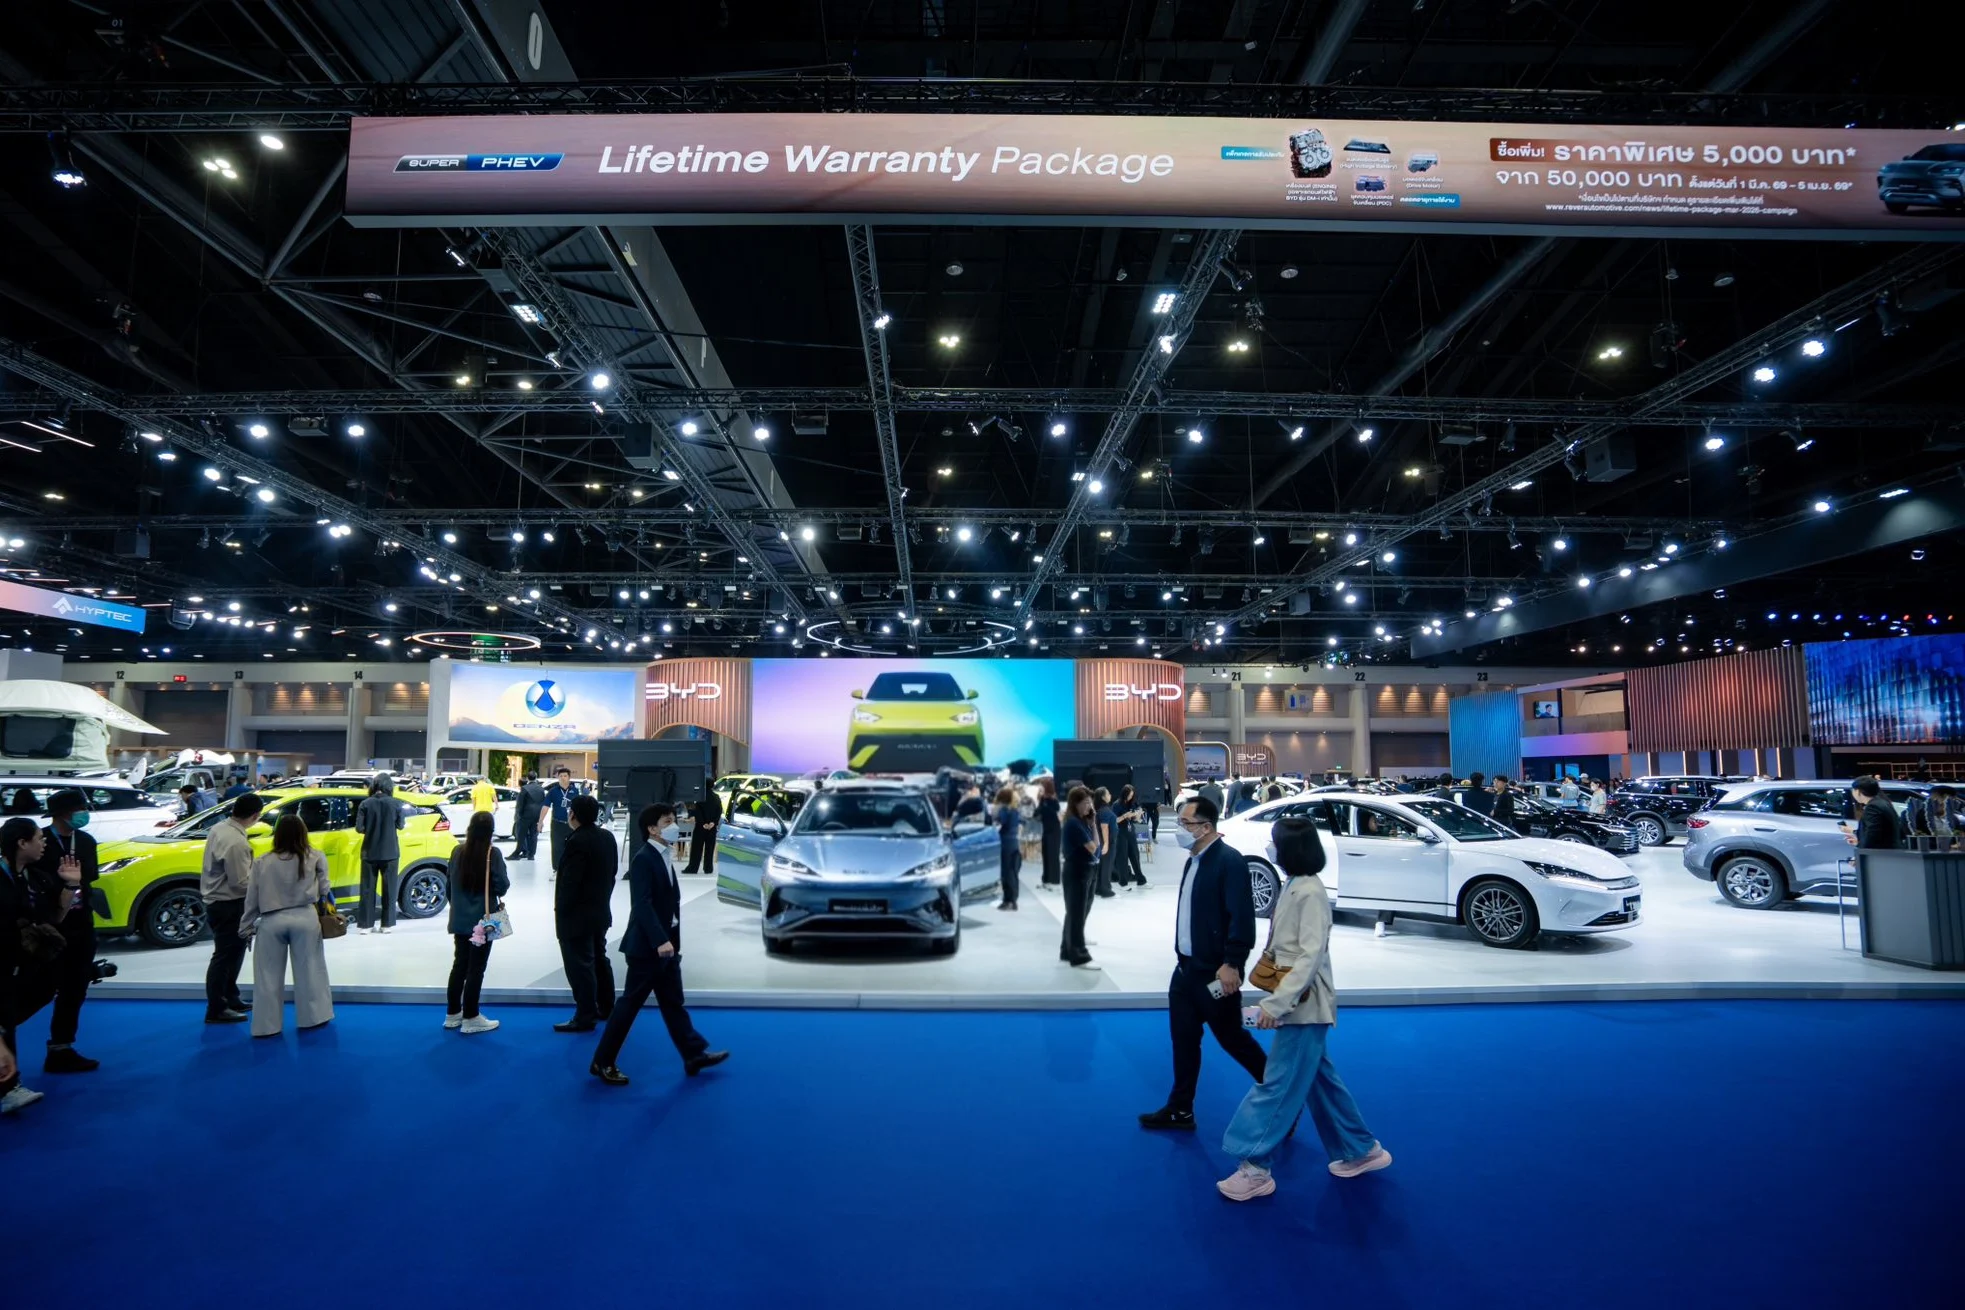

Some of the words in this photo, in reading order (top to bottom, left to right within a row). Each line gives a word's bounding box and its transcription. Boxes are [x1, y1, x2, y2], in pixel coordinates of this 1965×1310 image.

[1497, 140, 1545, 158] ซื้อเพิ่ม!
[1554, 140, 1695, 163] ราคาพิเศษ
[1703, 144, 1783, 167] 5,000
[408, 158, 460, 168] SUPER
[481, 156, 546, 168] PHEV
[598, 145, 769, 174] Lifetime
[783, 145, 980, 182] Warranty
[991, 146, 1175, 183] Package
[1496, 169, 1539, 185] จาก
[1547, 169, 1630, 189] 50,000
[1638, 172, 1682, 188] บาท
[1689, 175, 1738, 190] ตั้งแต่วันที่
[1740, 181, 1746, 189] 1
[1748, 179, 1770, 190] มี.ค.
[1772, 181, 1788, 190] 69
[75, 603, 133, 624] HYPTEC
[115, 669, 125, 680] 12
[233, 669, 244, 680] 13
[353, 670, 363, 680] 14
[1231, 671, 1241, 681] 21
[1354, 671, 1366, 682] 22
[1477, 671, 1489, 682] 23
[645, 682, 721, 700] BYD
[1104, 682, 1182, 701] BYD
[1236, 753, 1267, 761] BYD
